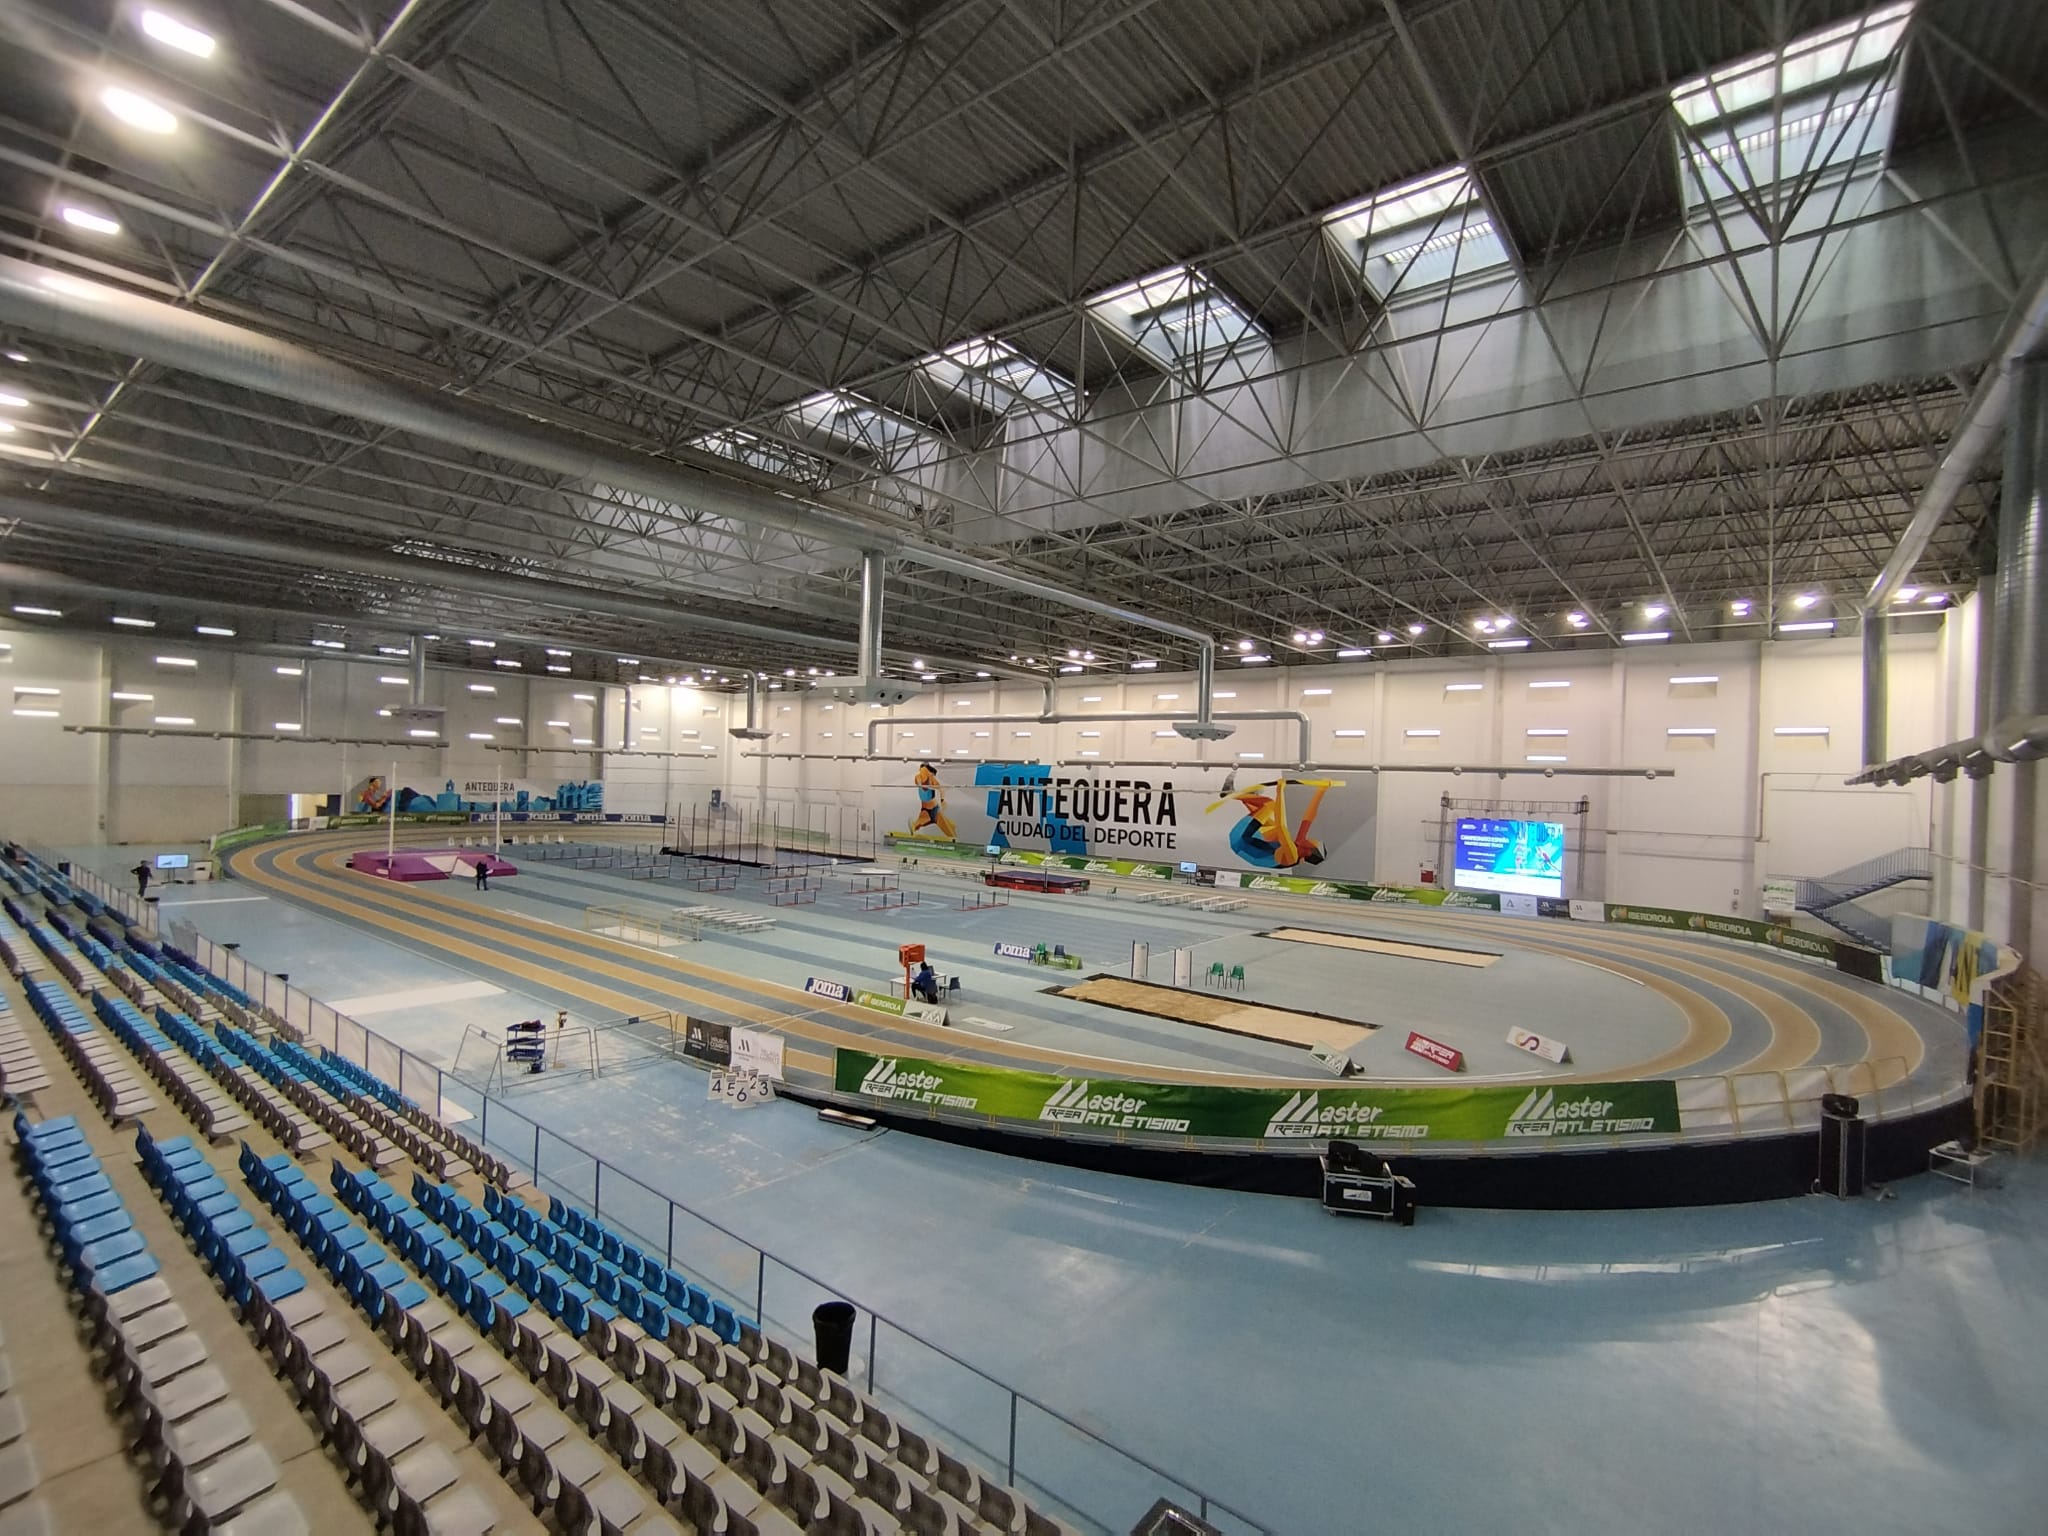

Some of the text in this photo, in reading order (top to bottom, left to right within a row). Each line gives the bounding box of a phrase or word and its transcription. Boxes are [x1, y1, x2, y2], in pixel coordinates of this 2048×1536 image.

[465, 781, 515, 793] ANTEQUERA
[998, 776, 1177, 826] ANTEQUERA
[996, 820, 1177, 849] CIUDAD DEL DEPORTE
[1628, 911, 1675, 925] IBERDROLA
[1705, 920, 1752, 936] IBERDROLA
[1783, 935, 1830, 954] IBERDROLA
[870, 998, 902, 1011] IBERDROLA
[750, 1075, 757, 1089] 2
[864, 1057, 943, 1090] Master
[712, 1080, 721, 1093] 4
[727, 1082, 736, 1096] 5
[736, 1087, 747, 1102] 6
[759, 1081, 769, 1096] 3
[865, 1082, 978, 1110] RFEA ATLETISMO
[1044, 1078, 1148, 1114] Master
[1509, 1087, 1614, 1121] Master
[1269, 1090, 1383, 1123] Master
[1046, 1107, 1191, 1133] RFEA ATLETISMO
[1510, 1117, 1655, 1136] RFEA ATLETISMO
[1272, 1124, 1430, 1138] RFEA ATLETISMO
